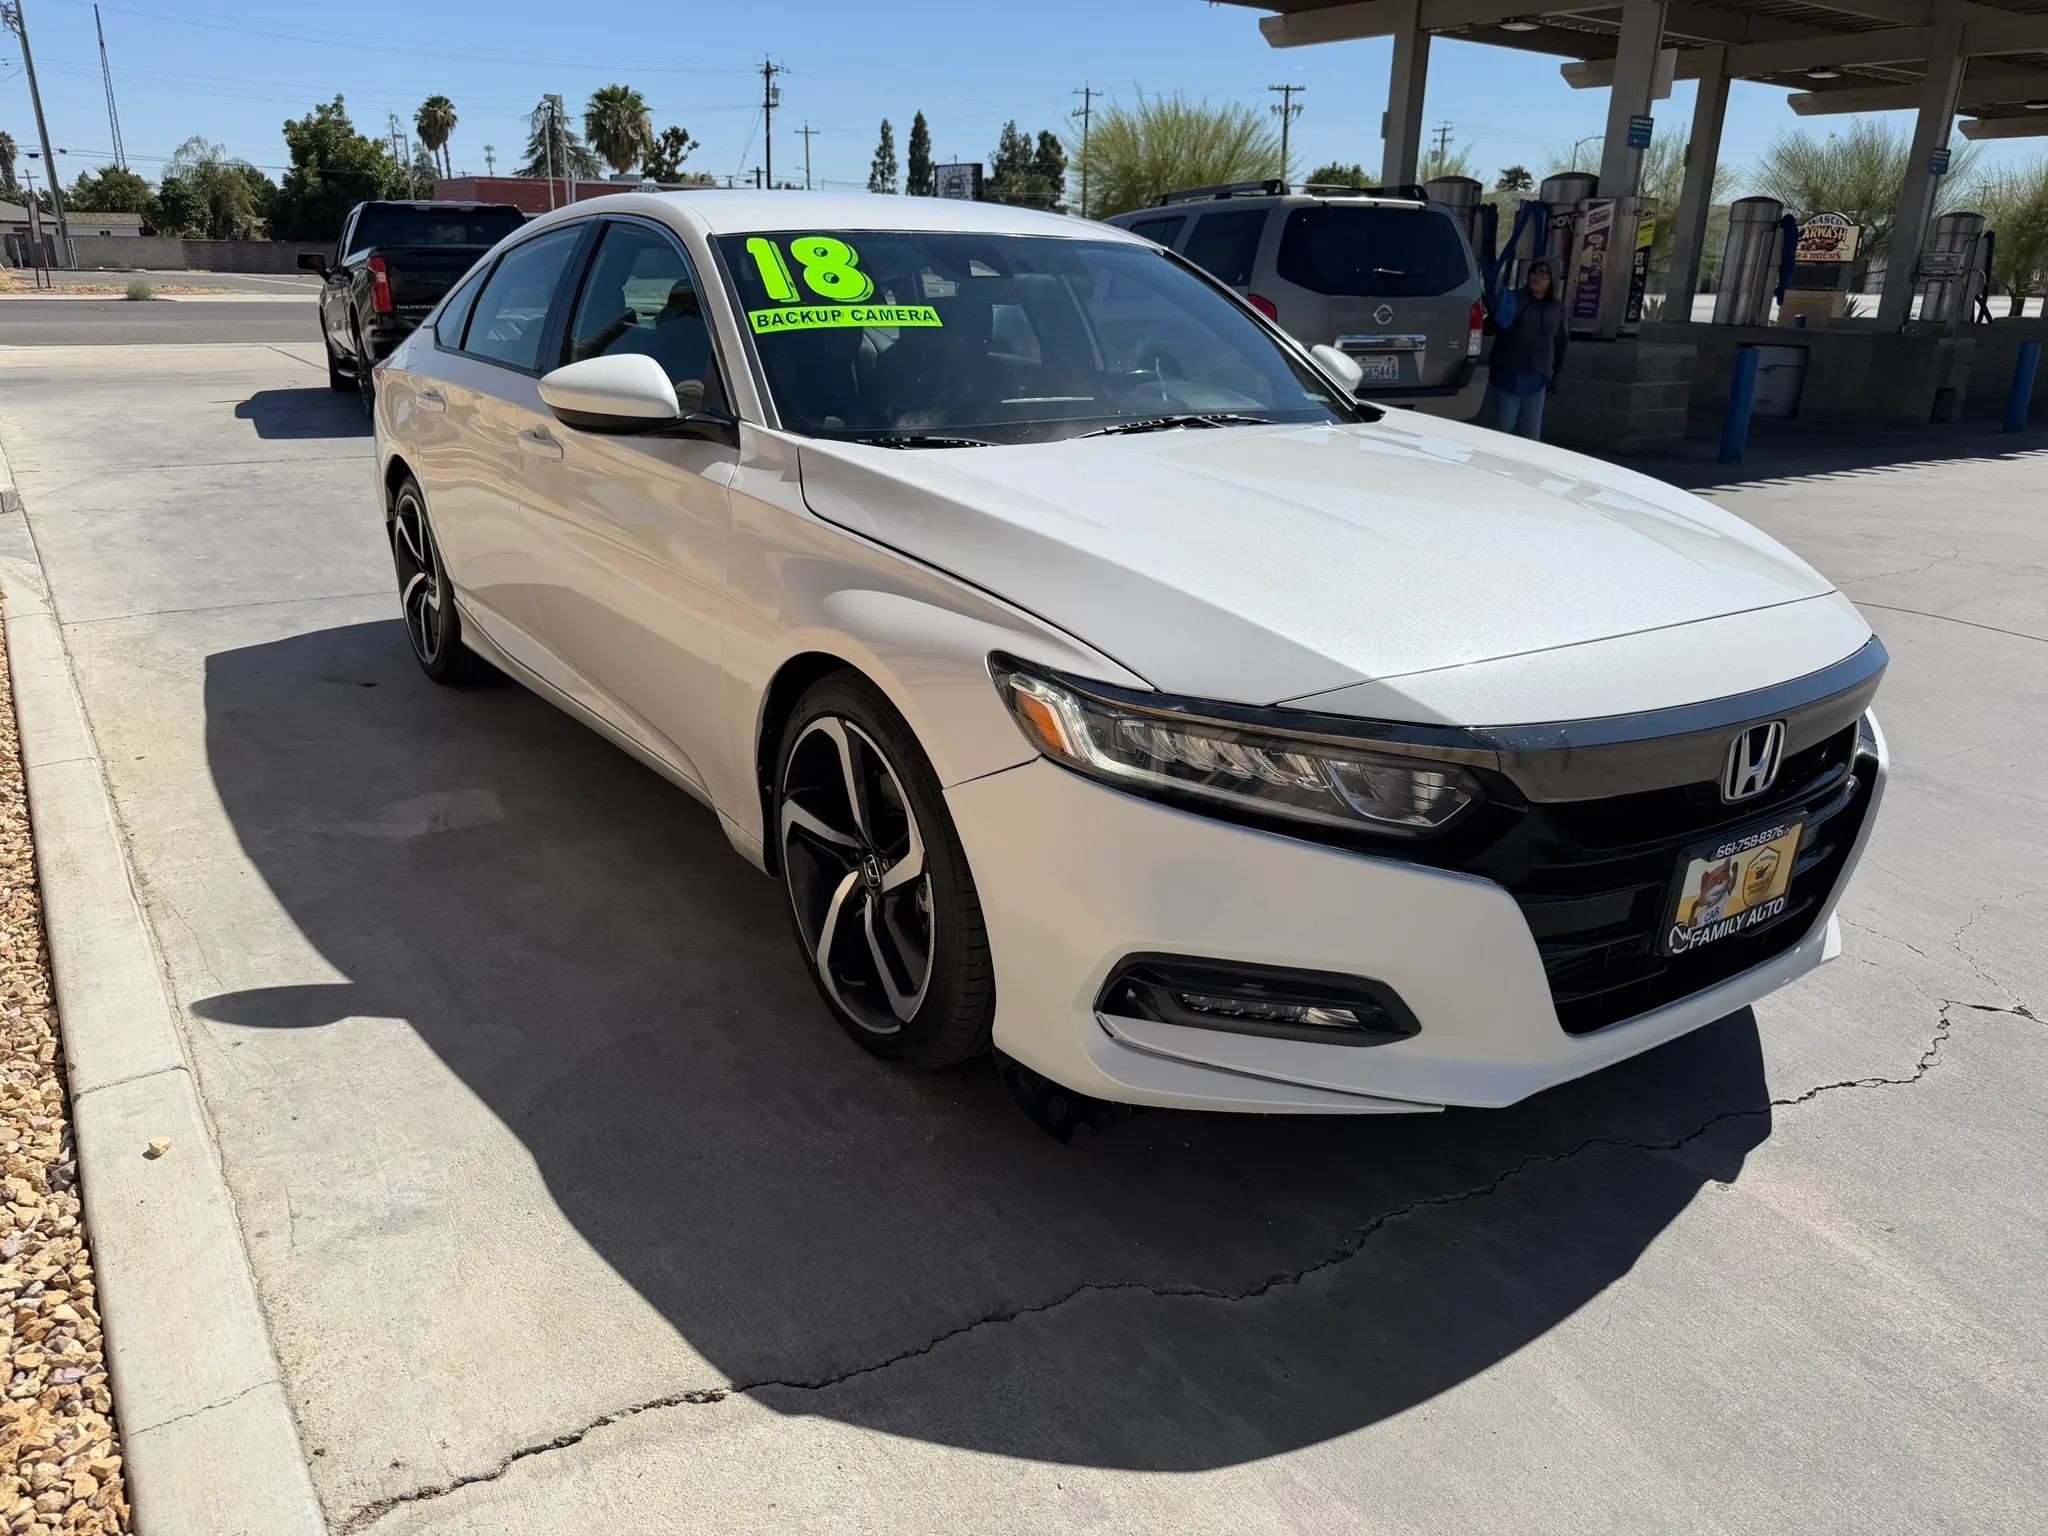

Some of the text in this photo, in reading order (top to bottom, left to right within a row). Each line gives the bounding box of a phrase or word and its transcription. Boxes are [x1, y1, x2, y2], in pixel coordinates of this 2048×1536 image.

[1808, 215, 1842, 225] WASCO
[746, 236, 875, 304] 18
[756, 308, 935, 328] BACKUP CAMERA
[1716, 825, 1785, 858] 661-758-8376
[1689, 912, 1746, 950] FAMILY
[1745, 896, 1785, 928] AUTO
